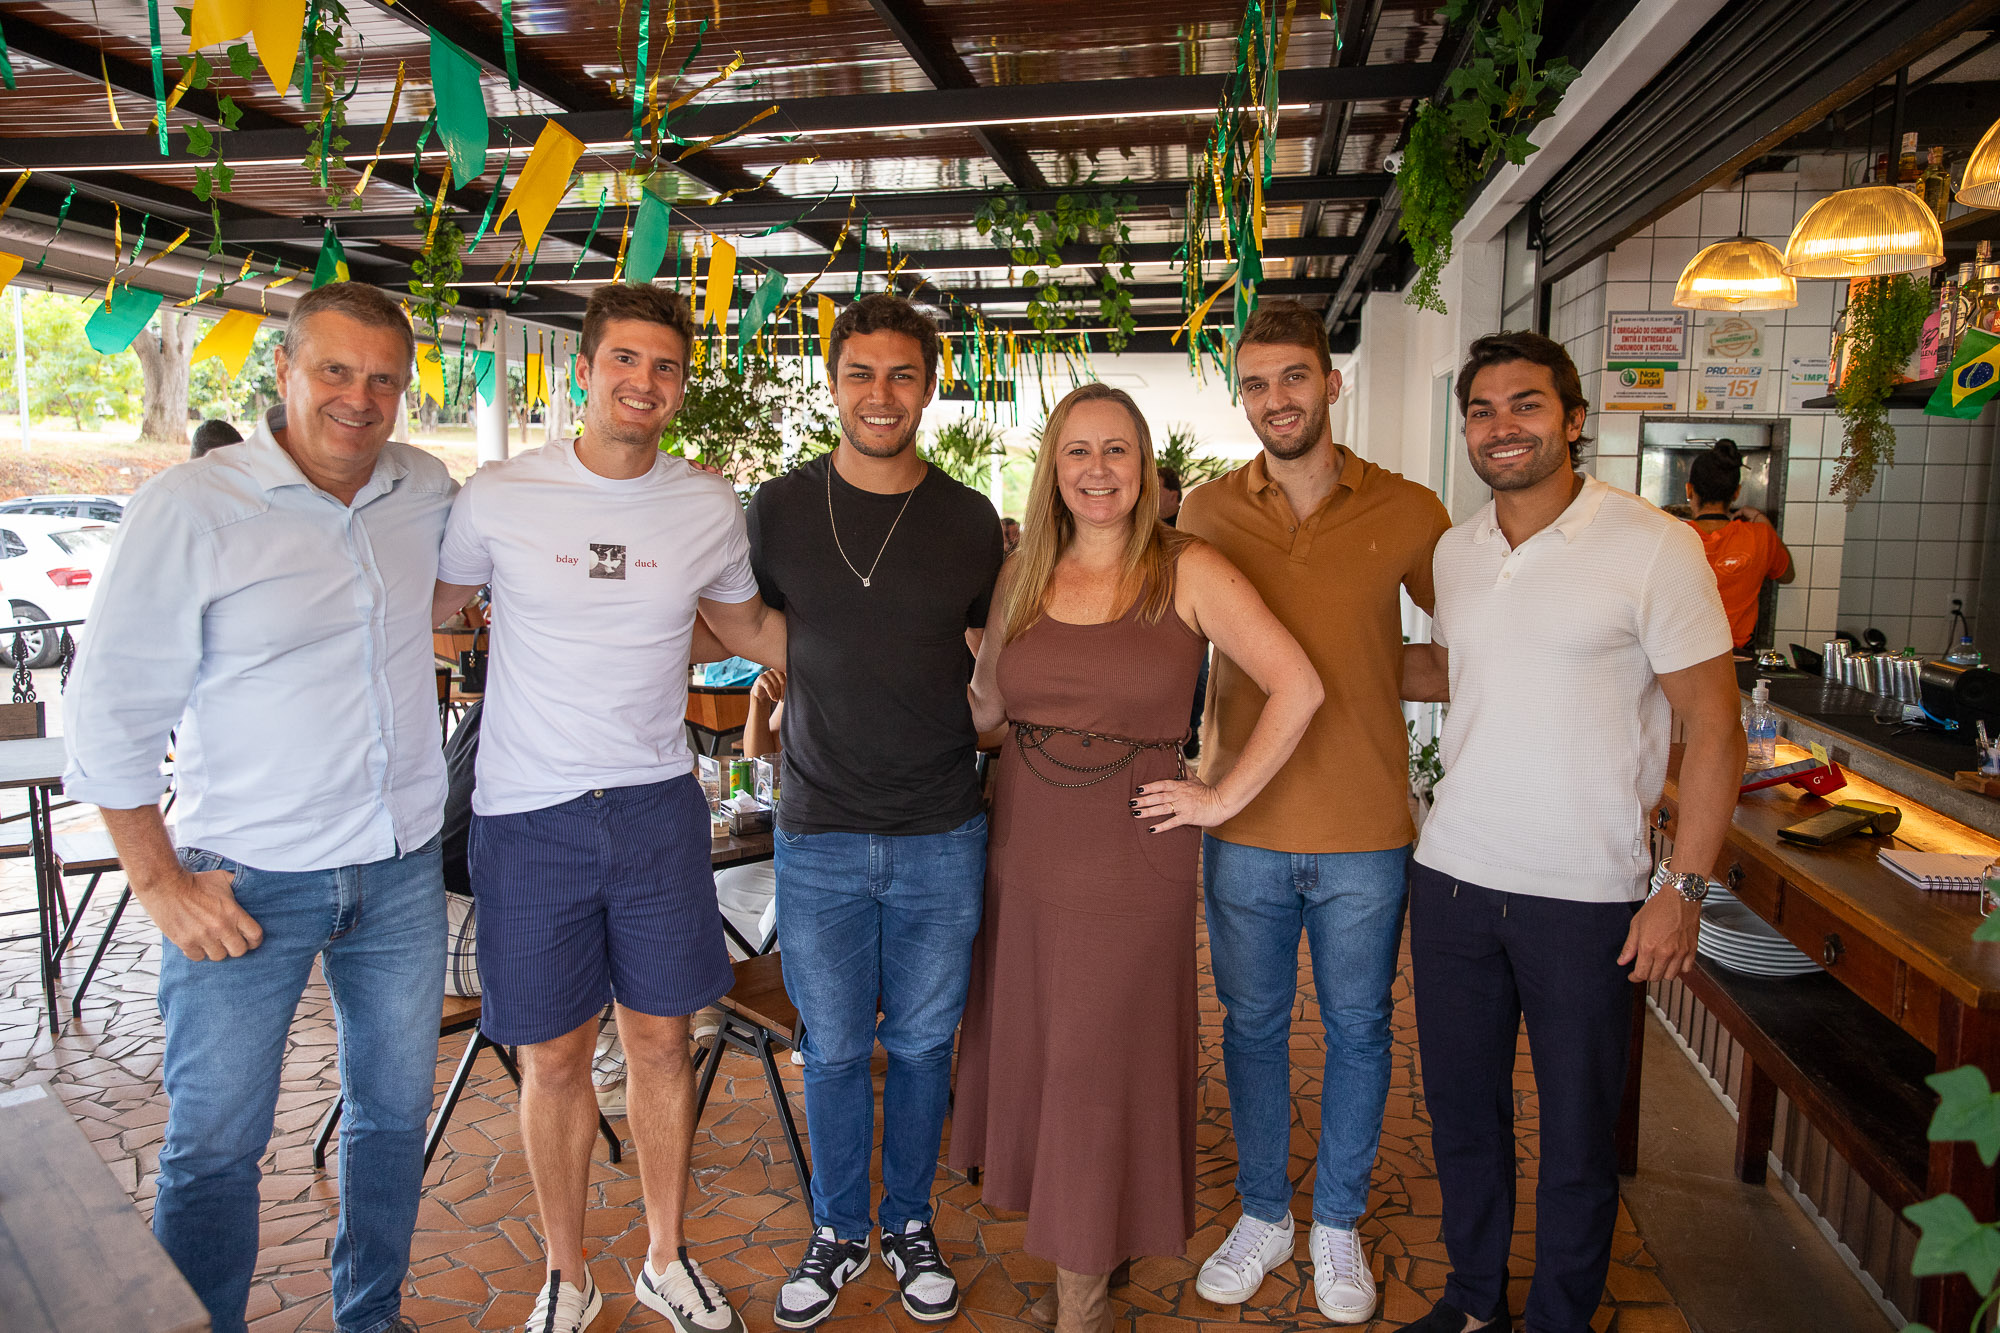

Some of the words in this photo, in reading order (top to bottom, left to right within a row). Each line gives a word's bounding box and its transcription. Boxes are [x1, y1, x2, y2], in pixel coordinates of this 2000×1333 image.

[1617, 326, 1642, 336] OBRIGAÇÃO
[1621, 335, 1637, 343] EMITIR
[1642, 335, 1665, 343] ENTREGAR
[1640, 370, 1660, 378] Nota
[1639, 378, 1661, 387] Legal
[1728, 379, 1759, 397] 151
[556, 554, 579, 566] bday
[634, 559, 658, 568] duck
